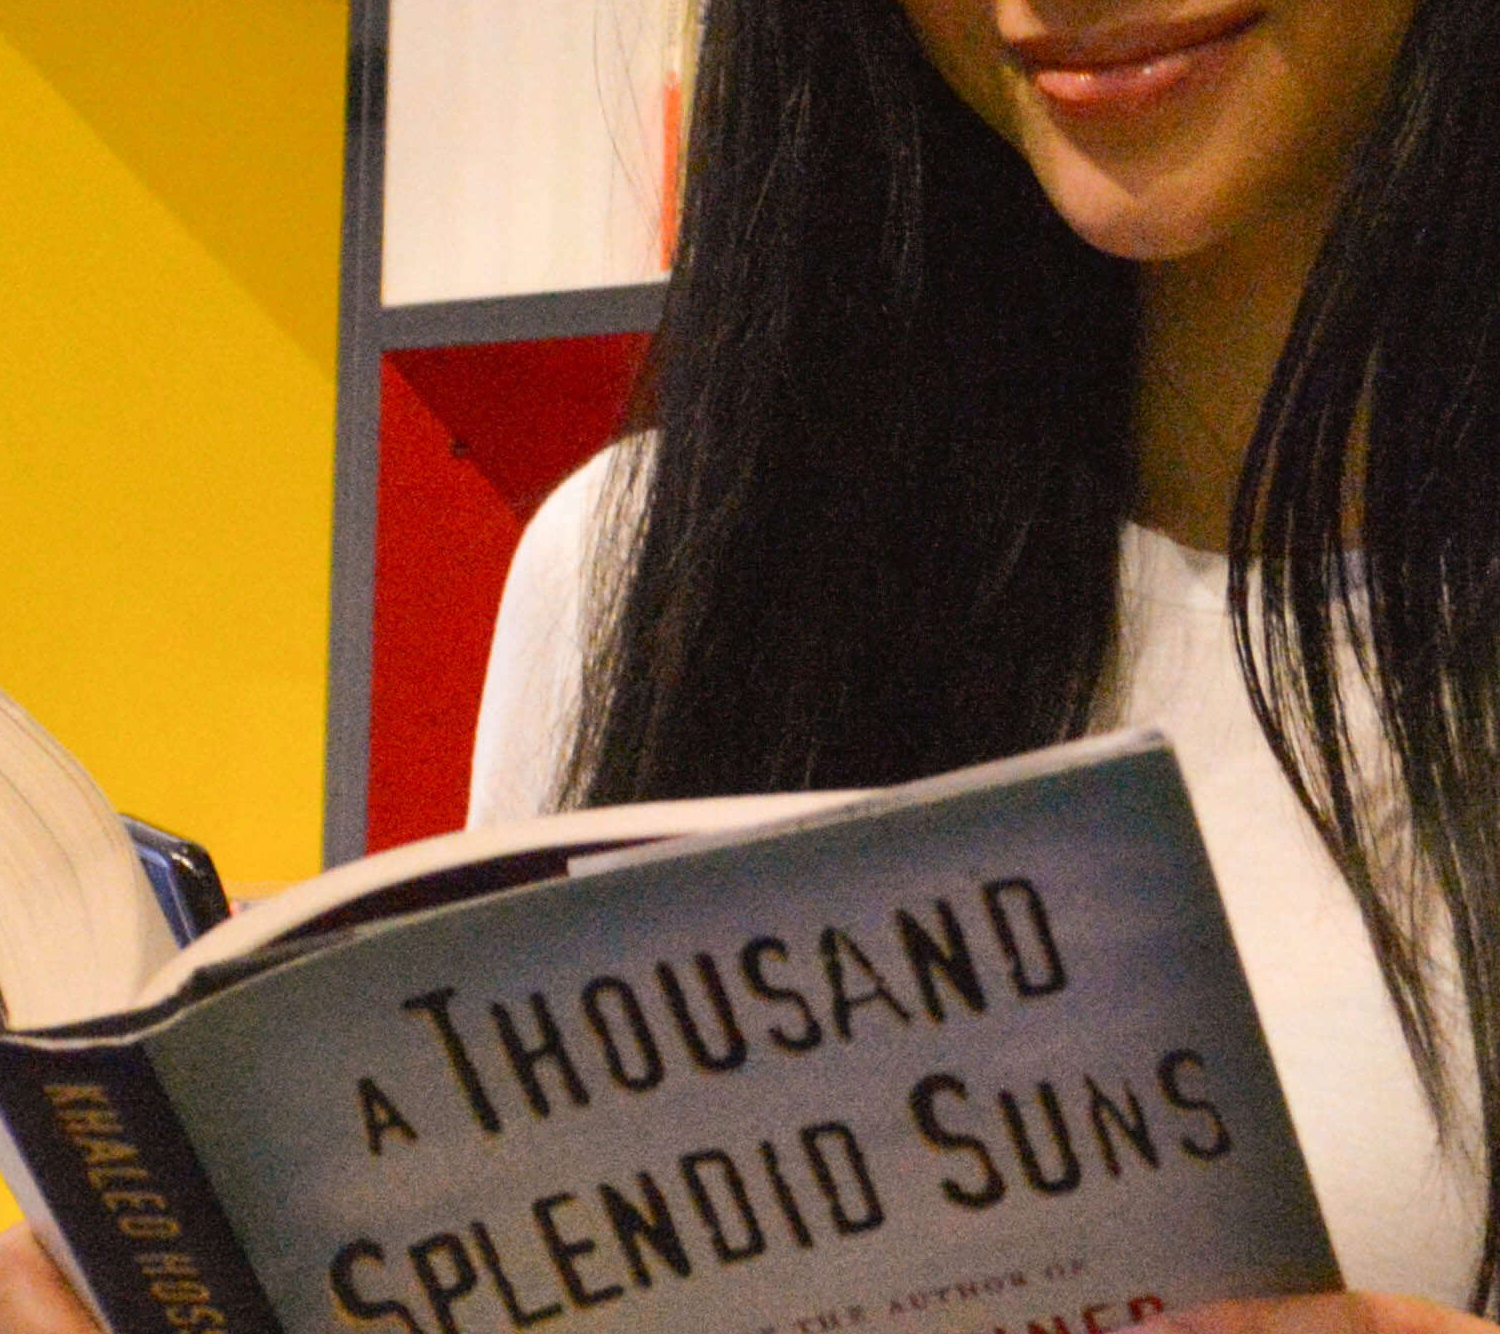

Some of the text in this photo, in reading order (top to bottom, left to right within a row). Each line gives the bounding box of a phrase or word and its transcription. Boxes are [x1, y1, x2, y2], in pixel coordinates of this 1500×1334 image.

[354, 876, 1067, 1156] A THOUSAND
[44, 1081, 180, 1247] KHALED
[909, 1048, 1233, 1212] SUNS
[887, 1268, 1029, 1320] AUTHOR
